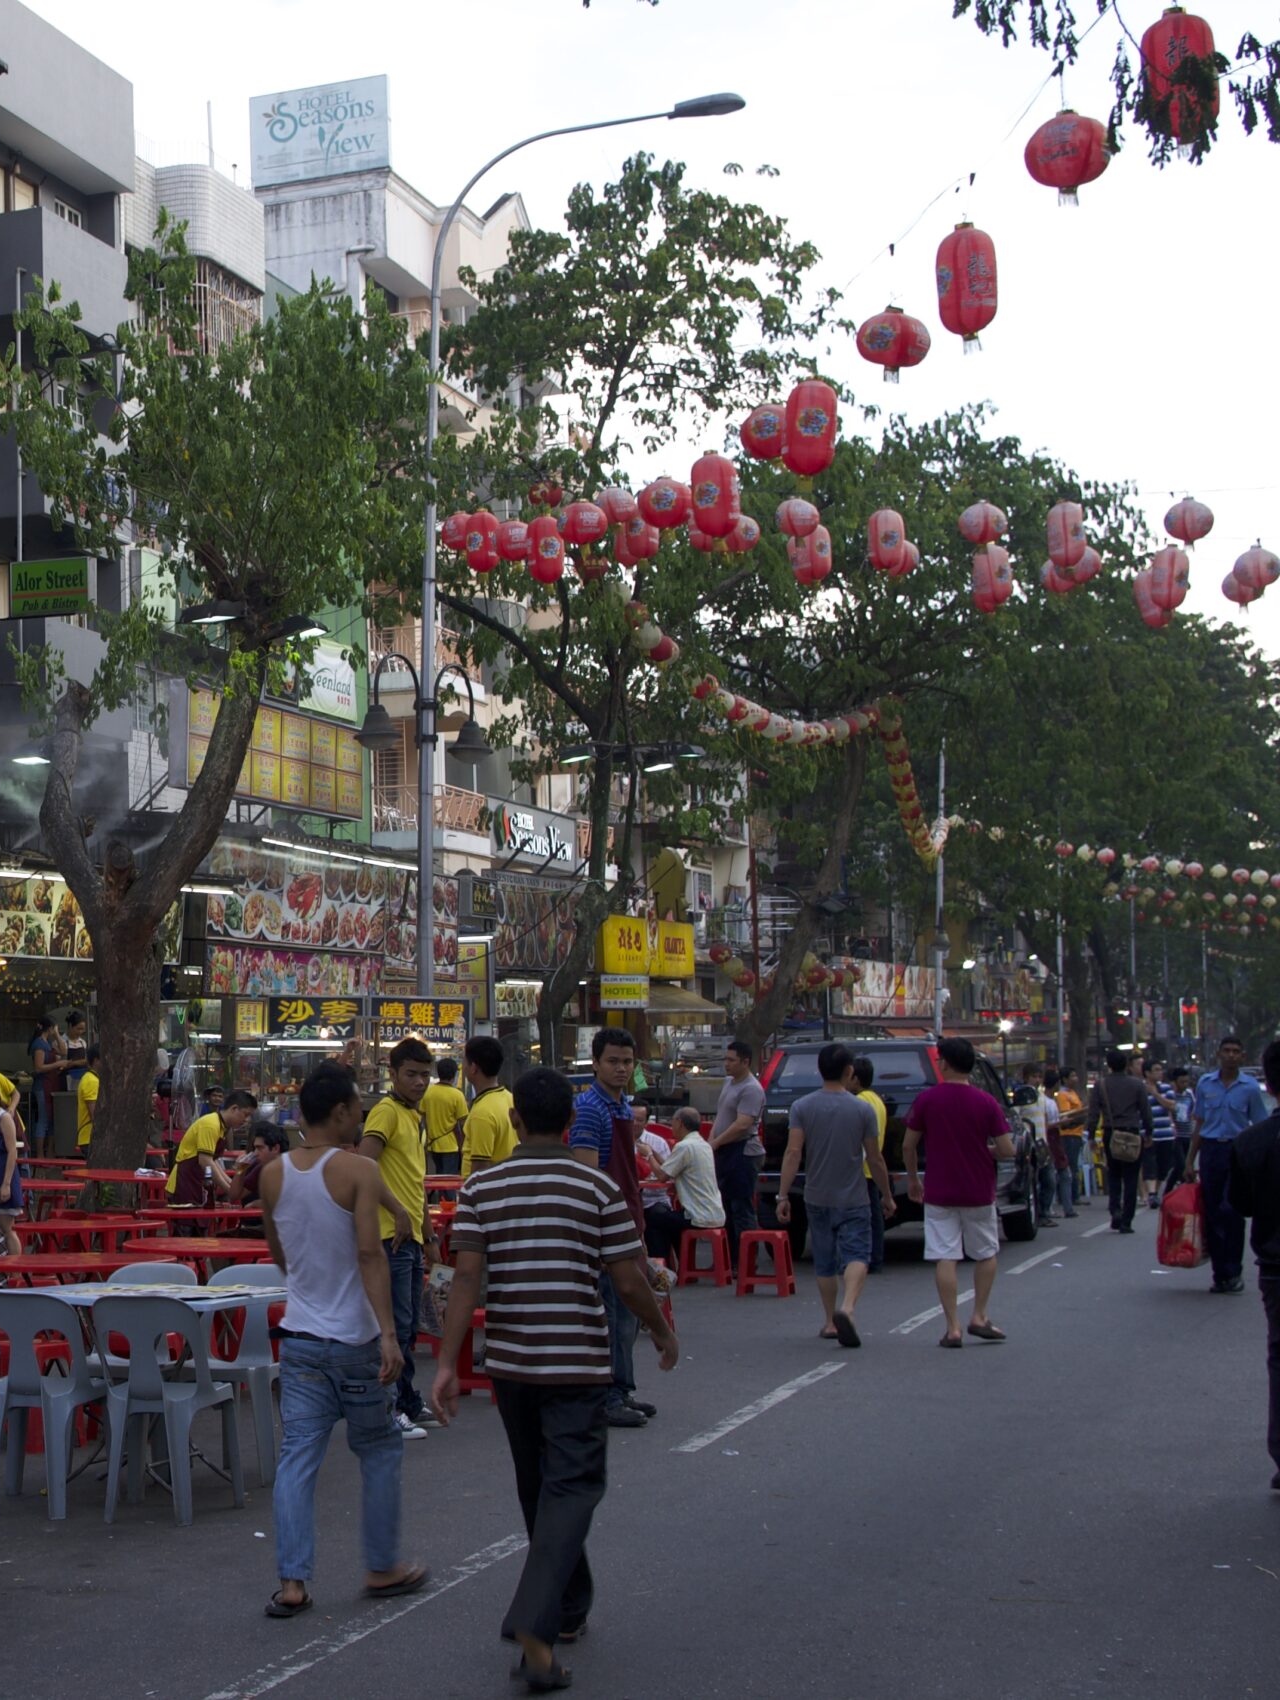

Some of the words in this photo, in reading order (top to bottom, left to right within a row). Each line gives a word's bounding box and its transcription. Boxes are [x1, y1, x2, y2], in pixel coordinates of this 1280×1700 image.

[297, 91, 356, 112] HOTEL
[270, 98, 375, 143] Seasons
[15, 571, 42, 592] Alor
[45, 569, 85, 590] Street
[22, 599, 39, 612] Pub
[40, 598, 49, 610] &
[51, 597, 80, 610] Bistro
[312, 668, 352, 697] reenland
[604, 987, 640, 997] HOTEL
[276, 999, 360, 1024] 沙爹
